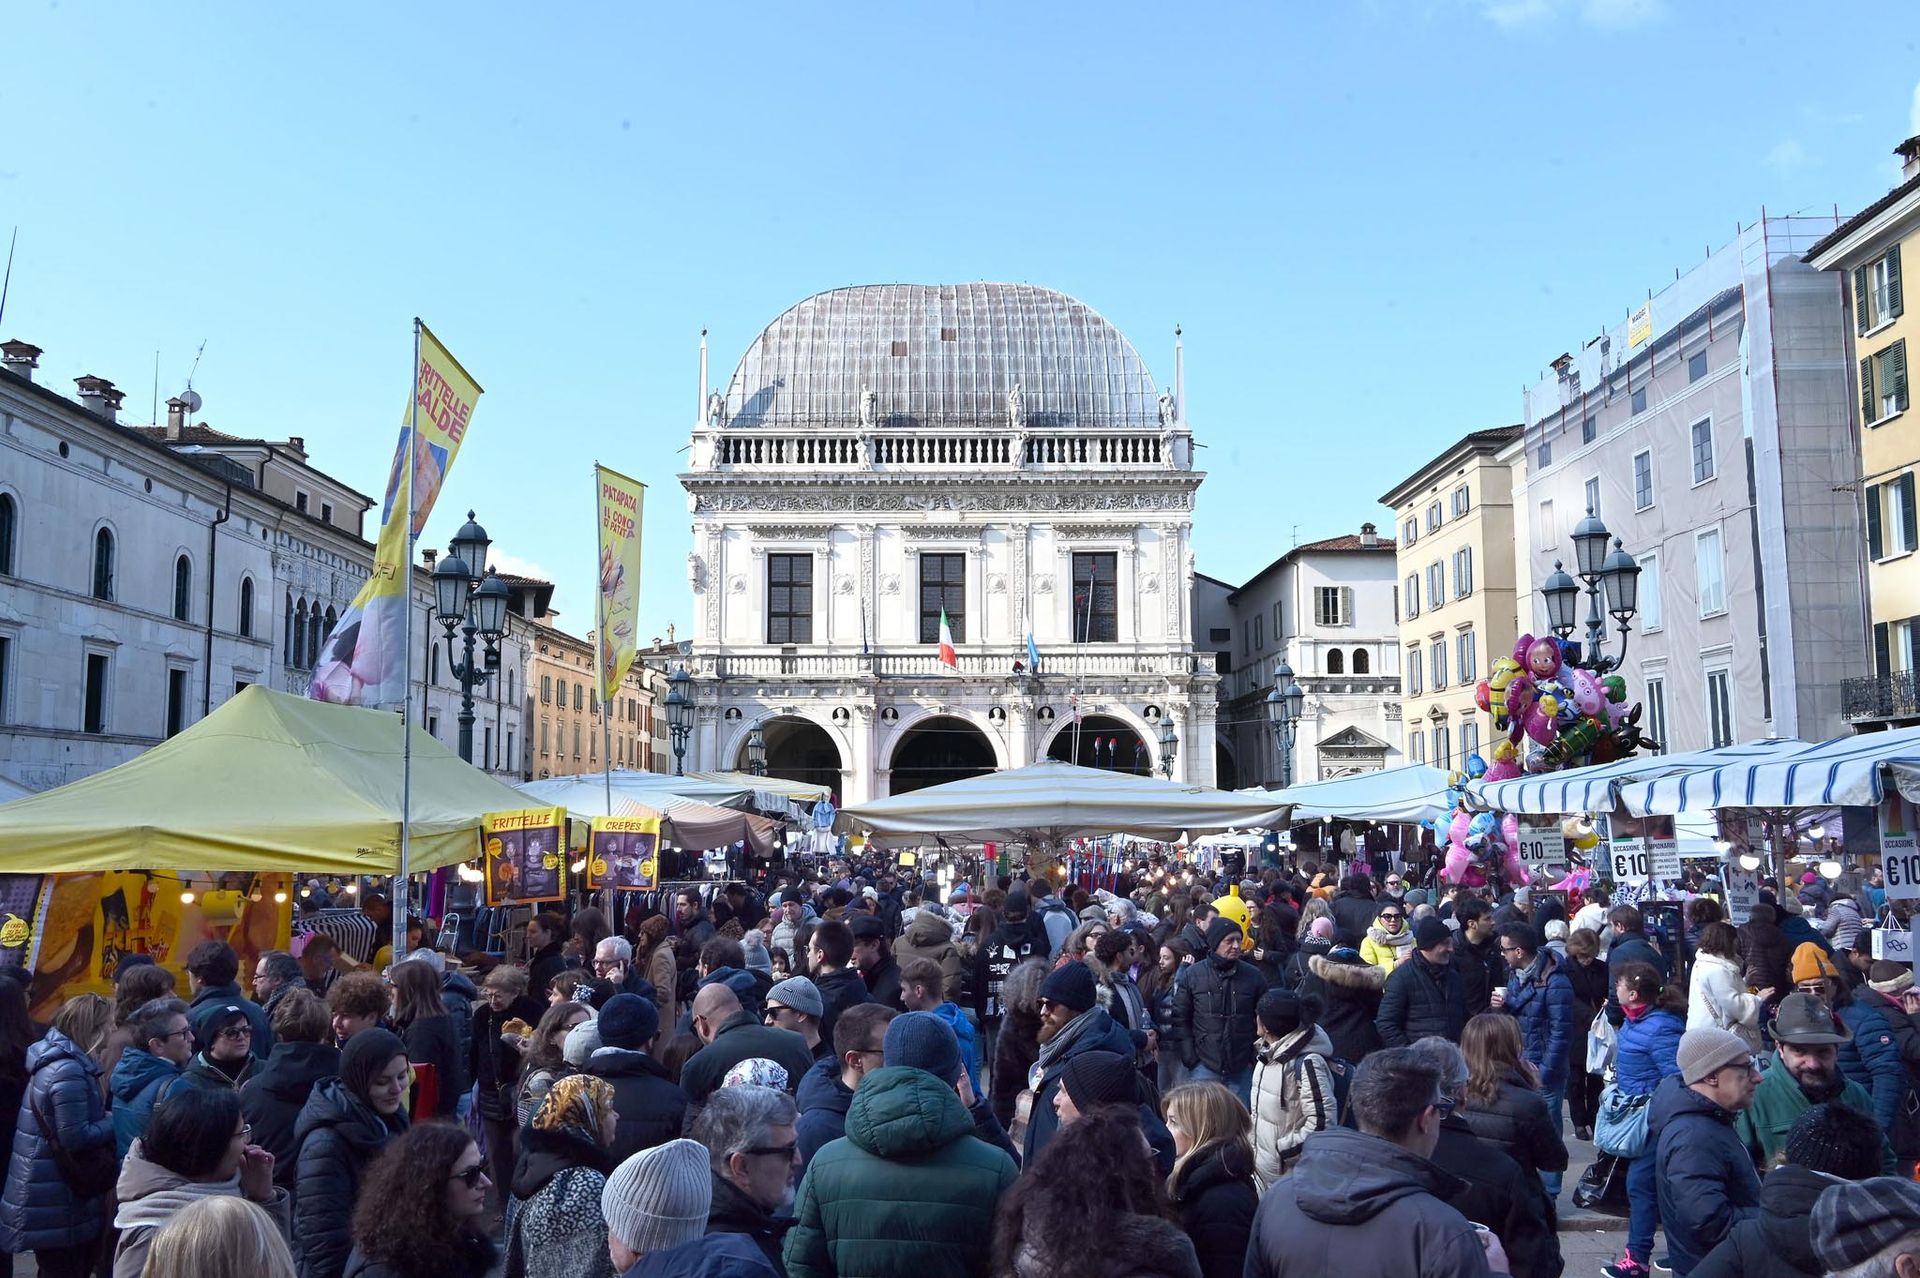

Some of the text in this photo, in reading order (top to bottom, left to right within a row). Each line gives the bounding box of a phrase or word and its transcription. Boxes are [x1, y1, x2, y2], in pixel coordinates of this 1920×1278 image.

[418, 378, 465, 444] ALDE
[602, 484, 637, 513] PATAPATA
[612, 510, 635, 530] CONO
[492, 813, 551, 830] FRITTELLE
[605, 821, 642, 831] CREPES
[1520, 841, 1544, 860] €10
[1613, 842, 1676, 852] OCCASIONE CMPIONARIO
[1884, 839, 1914, 849] OCCASIONE
[1614, 853, 1648, 877] €10
[1886, 855, 1920, 886] €10
